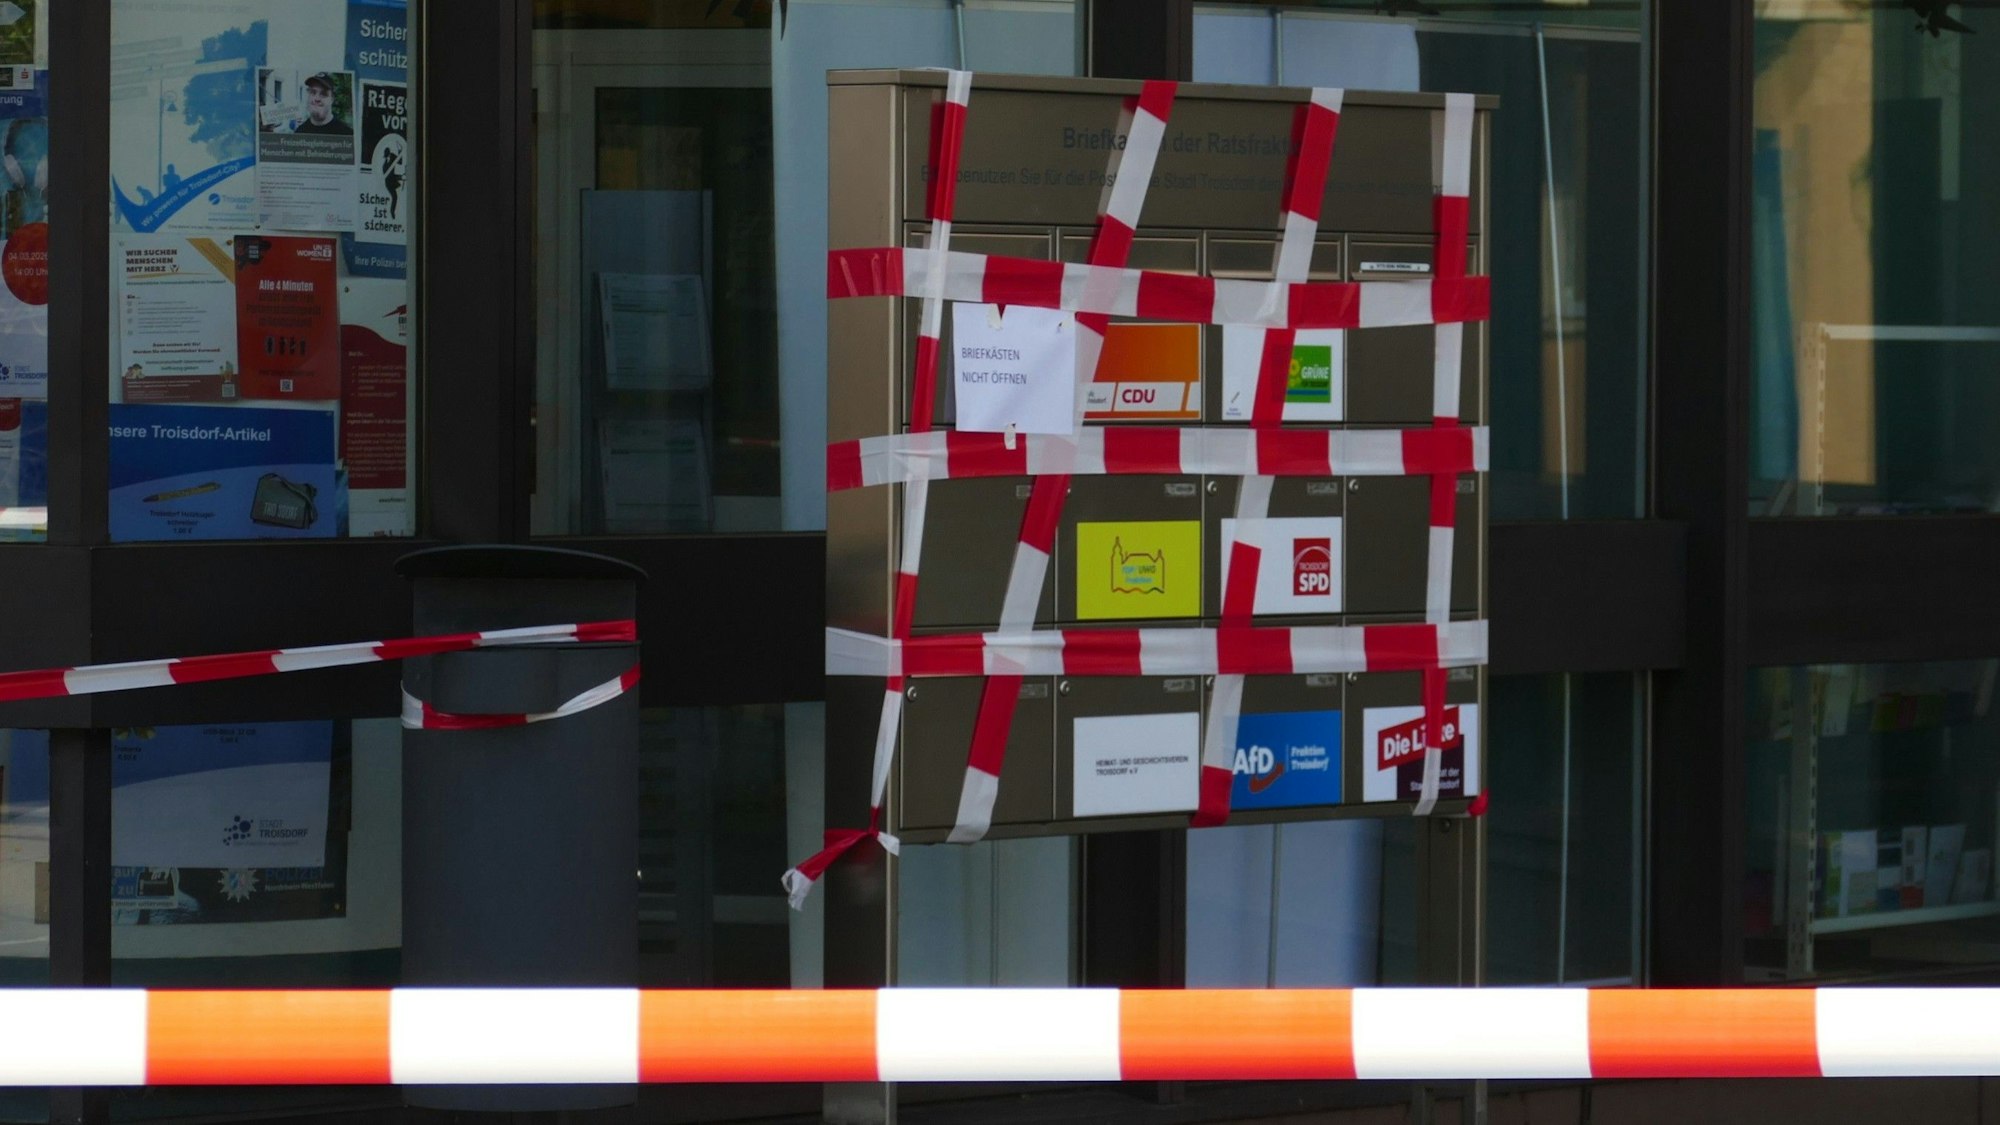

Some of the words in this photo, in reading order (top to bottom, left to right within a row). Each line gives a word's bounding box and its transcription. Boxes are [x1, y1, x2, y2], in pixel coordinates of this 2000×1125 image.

[1173, 130, 1202, 153] der
[1020, 168, 1041, 185] Sie
[360, 193, 390, 206] Sicher
[373, 206, 388, 219] ist
[126, 257, 174, 265] MENSCHEN
[258, 279, 274, 291] Alle
[275, 279, 282, 291] 4
[962, 346, 1020, 361] BRIEFKÄSTEN
[962, 371, 989, 383] NICHT
[991, 371, 1027, 385] ÖFFNEN
[1301, 363, 1329, 380] GRÜNE
[1122, 389, 1155, 404] CDU
[151, 425, 271, 442] Troisdorf-Artikel
[1299, 572, 1329, 592] SPD
[1383, 733, 1411, 761] Die
[1411, 723, 1455, 752] Lie
[1232, 745, 1275, 776] AfD
[1291, 745, 1326, 757] Fraktion
[1291, 757, 1330, 772] Troisdorf
[259, 828, 308, 839] TROISDORF
